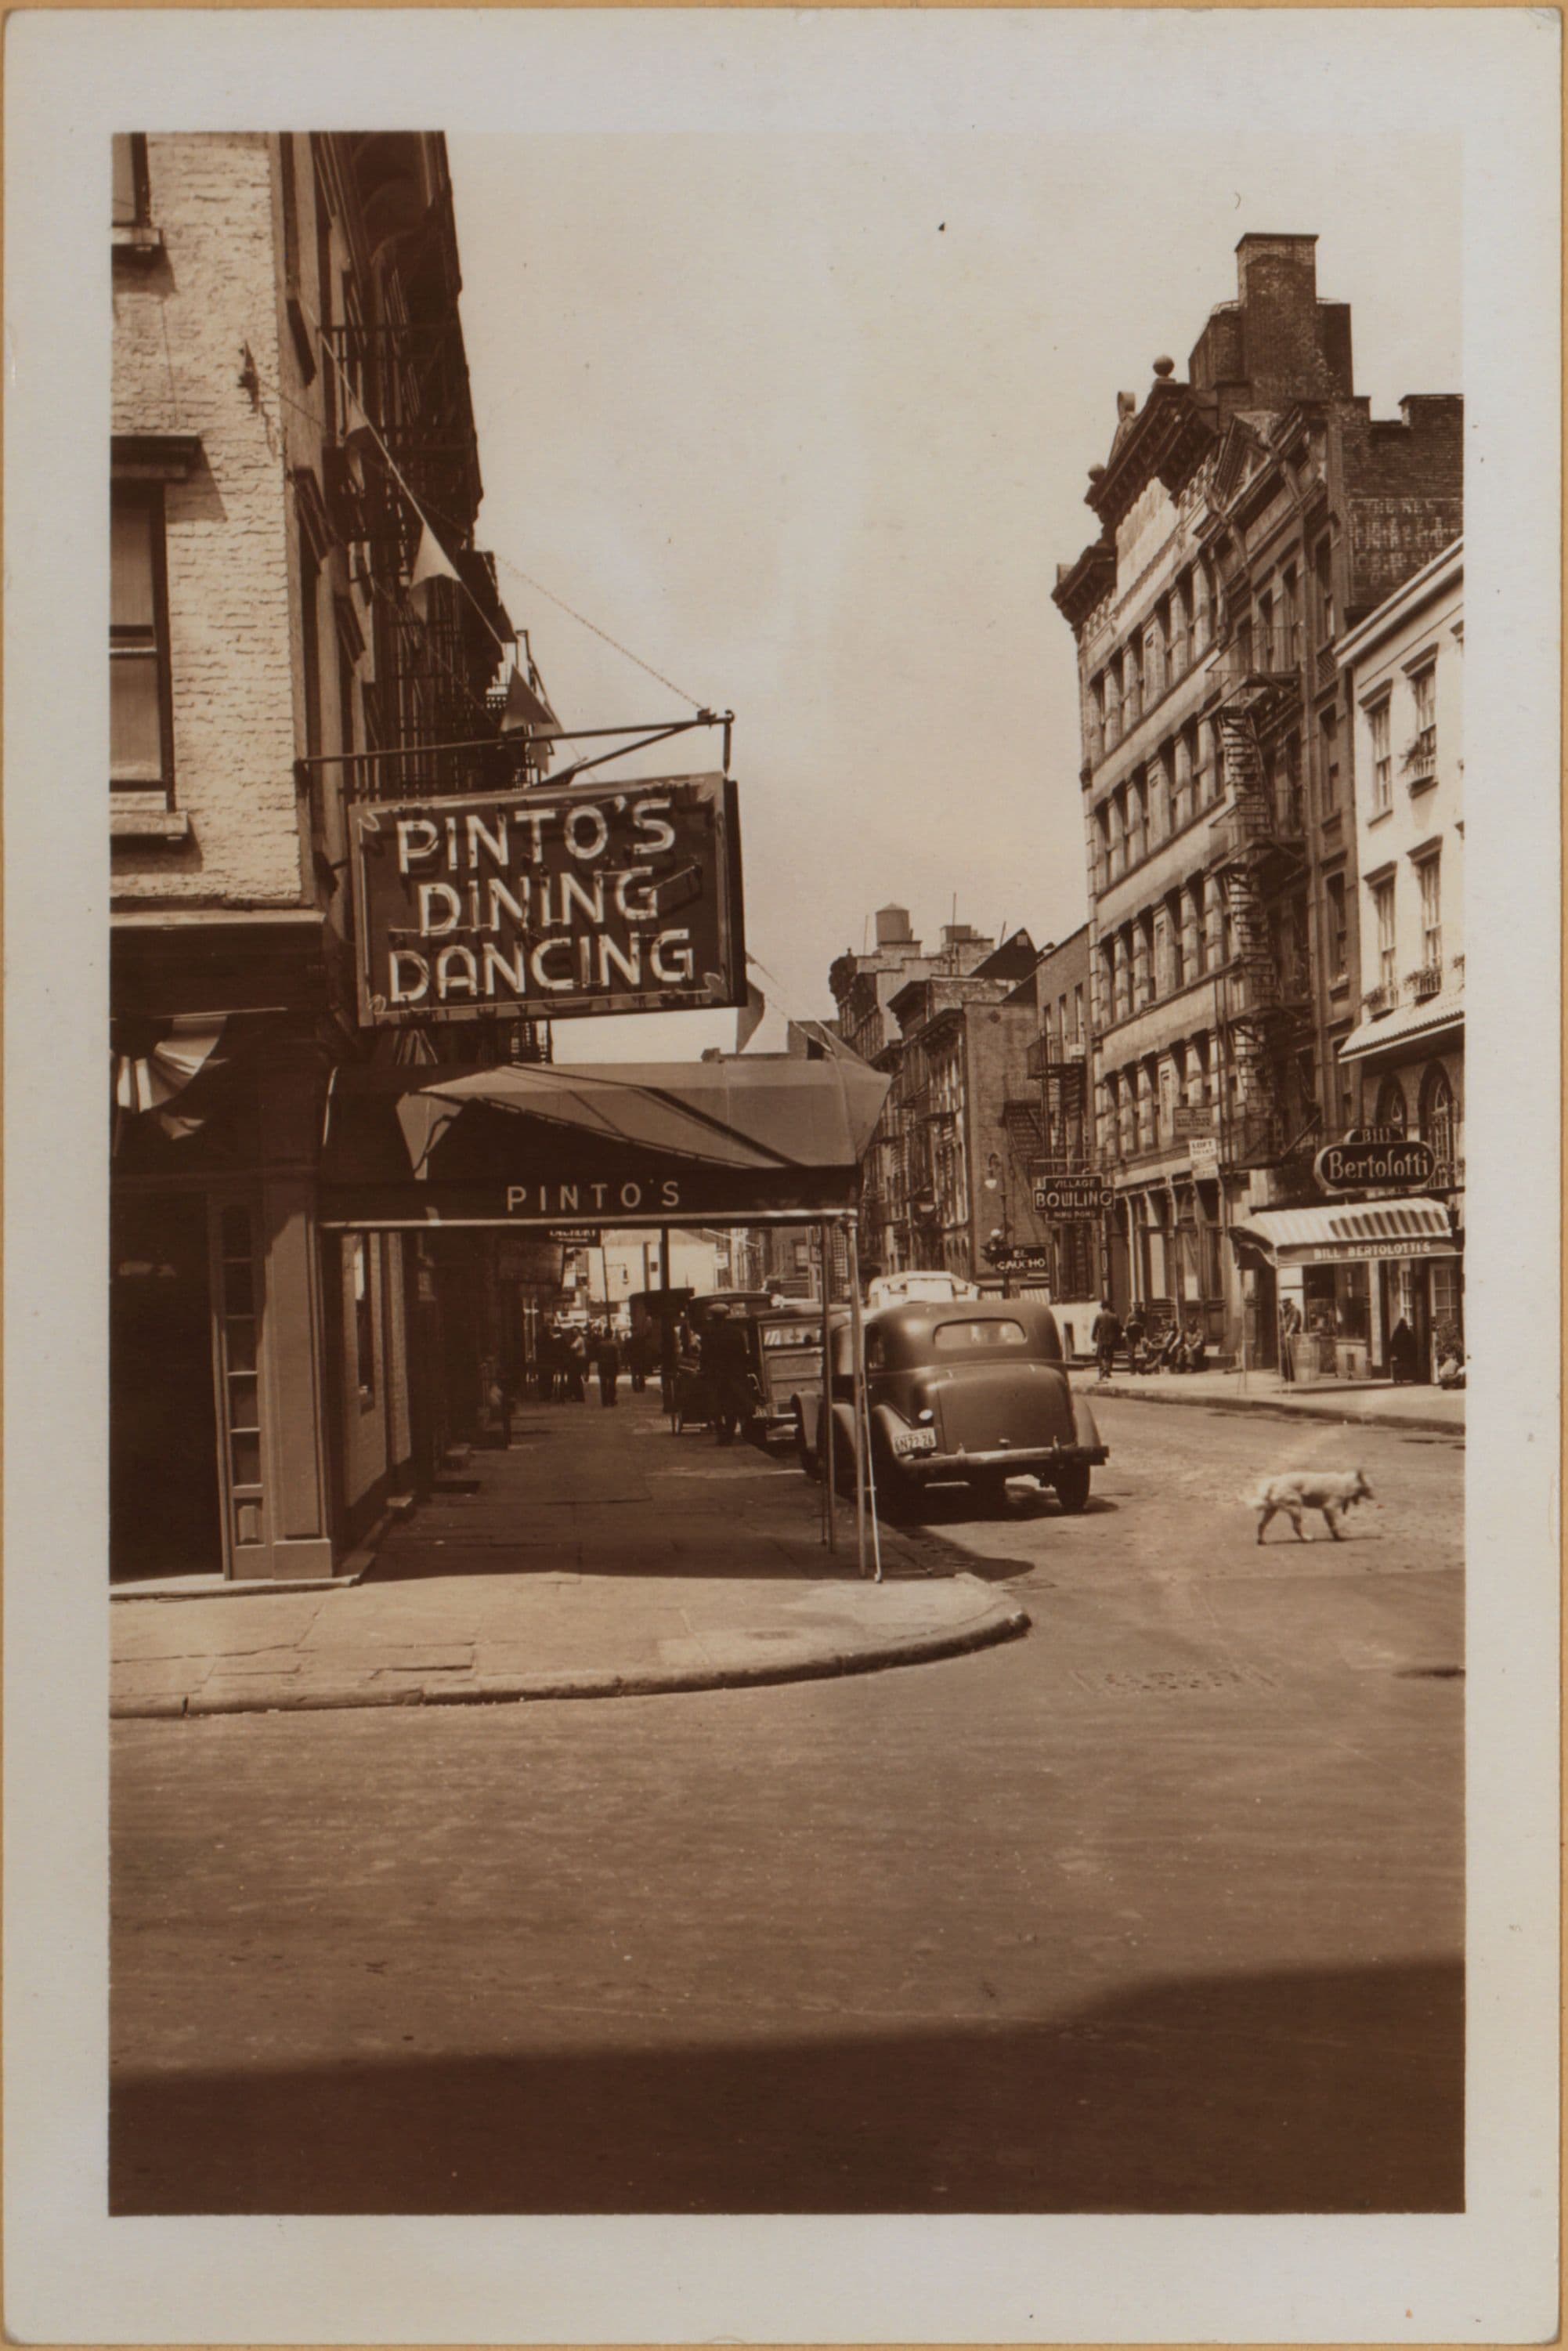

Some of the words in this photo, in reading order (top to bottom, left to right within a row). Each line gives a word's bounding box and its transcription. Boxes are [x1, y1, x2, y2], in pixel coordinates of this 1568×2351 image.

[397, 796, 676, 873] PINTO'S
[418, 866, 659, 937] DINING
[390, 928, 693, 1003] DANCING
[1328, 1148, 1429, 1181] Bertolotti
[507, 1178, 681, 1212] PINTO'S
[1035, 1190, 1112, 1207] BOWLING
[1054, 1178, 1096, 1188] VILLAGE
[1313, 1247, 1342, 1260] BILL
[1347, 1241, 1431, 1258] BERTOLOTTI'S
